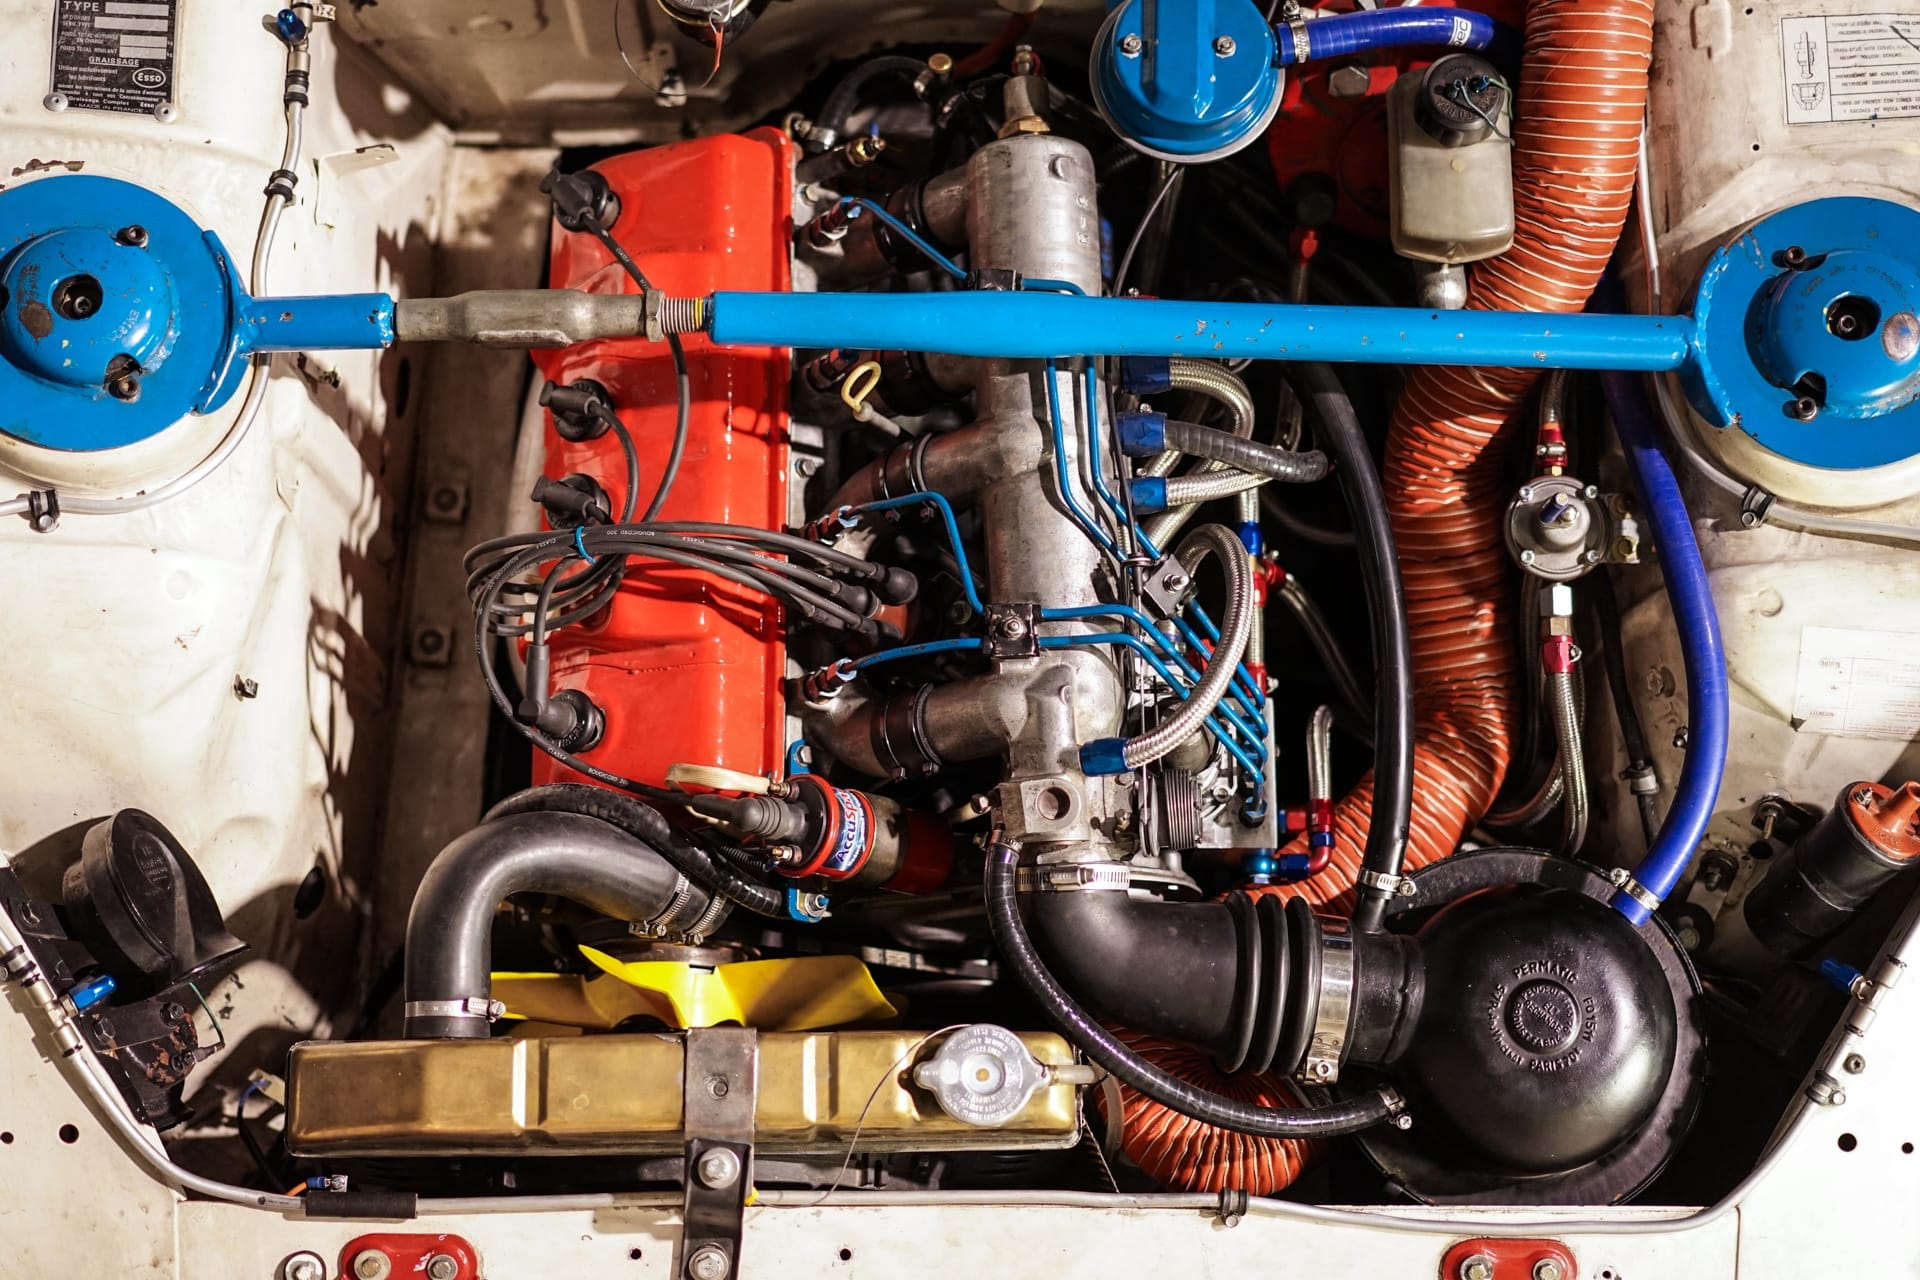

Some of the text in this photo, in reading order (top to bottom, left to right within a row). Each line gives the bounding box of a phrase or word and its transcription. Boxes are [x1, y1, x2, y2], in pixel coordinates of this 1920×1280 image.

[63, 0, 100, 12] TYPE
[88, 56, 140, 65] GRAISSAGE
[137, 72, 162, 82] Esso
[1512, 960, 1580, 985] PERMATIC
